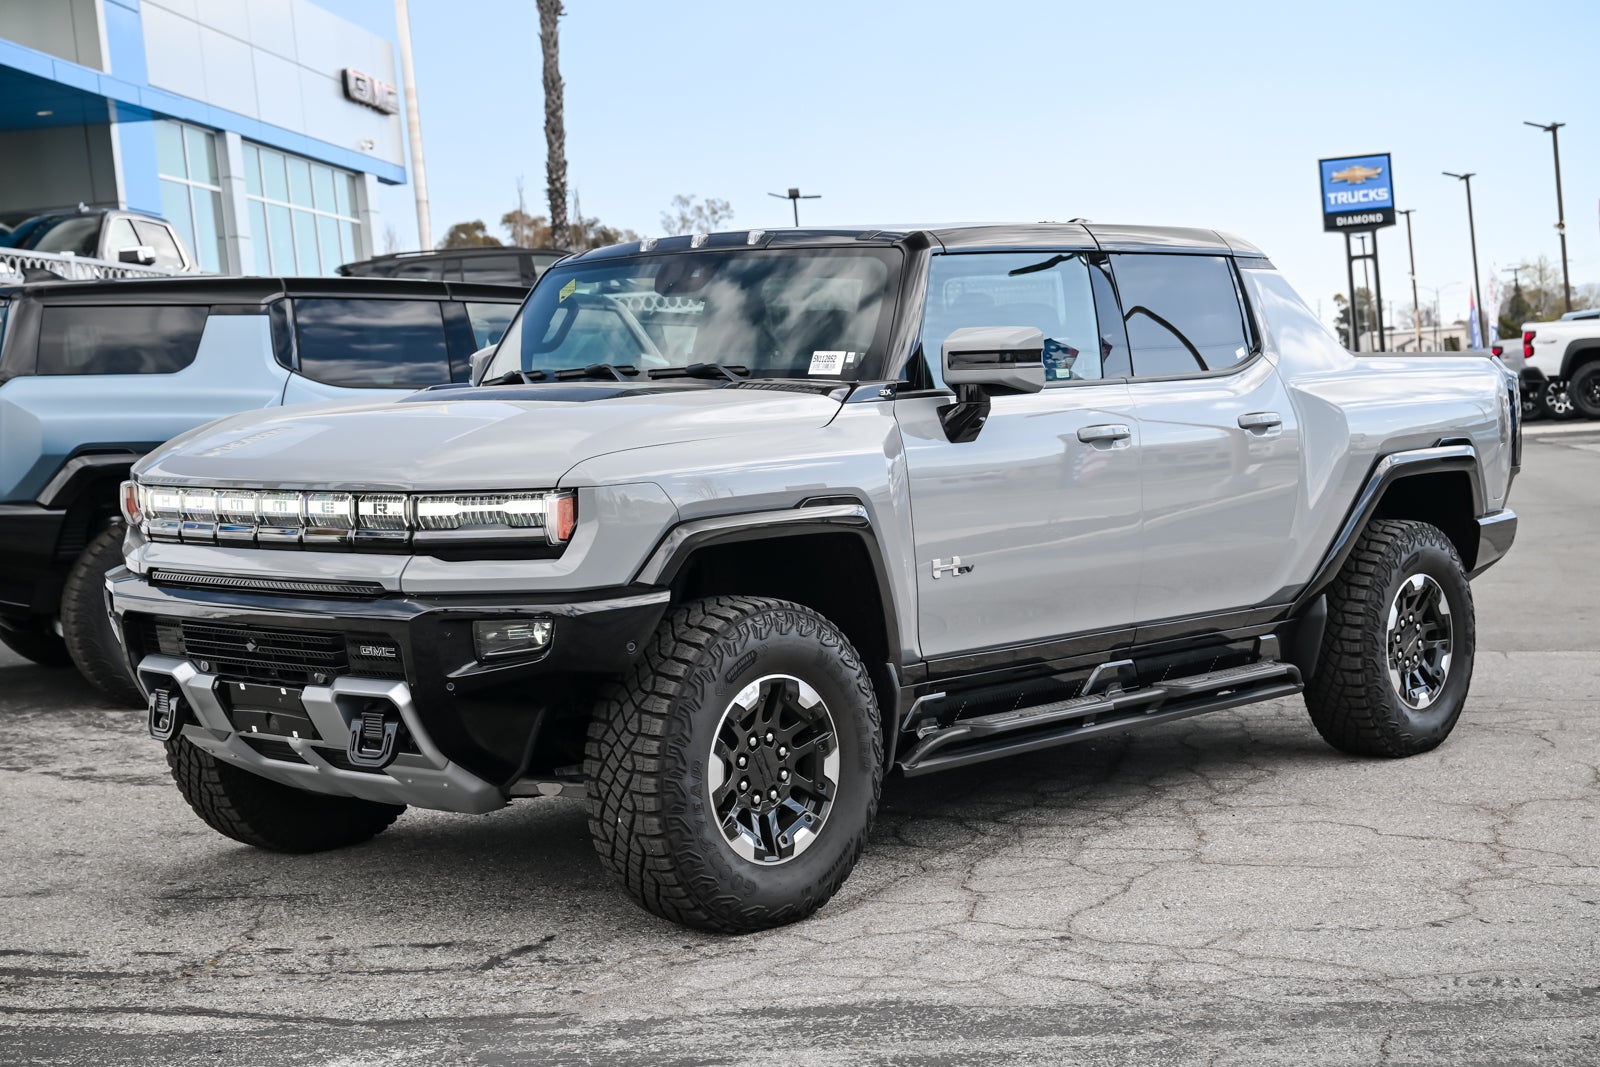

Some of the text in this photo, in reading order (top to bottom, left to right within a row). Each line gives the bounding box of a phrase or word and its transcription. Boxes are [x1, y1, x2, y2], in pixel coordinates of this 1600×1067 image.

[1327, 187, 1389, 205] TRUCKS
[1336, 213, 1384, 226] DIAMOND
[360, 645, 396, 657] GMC
